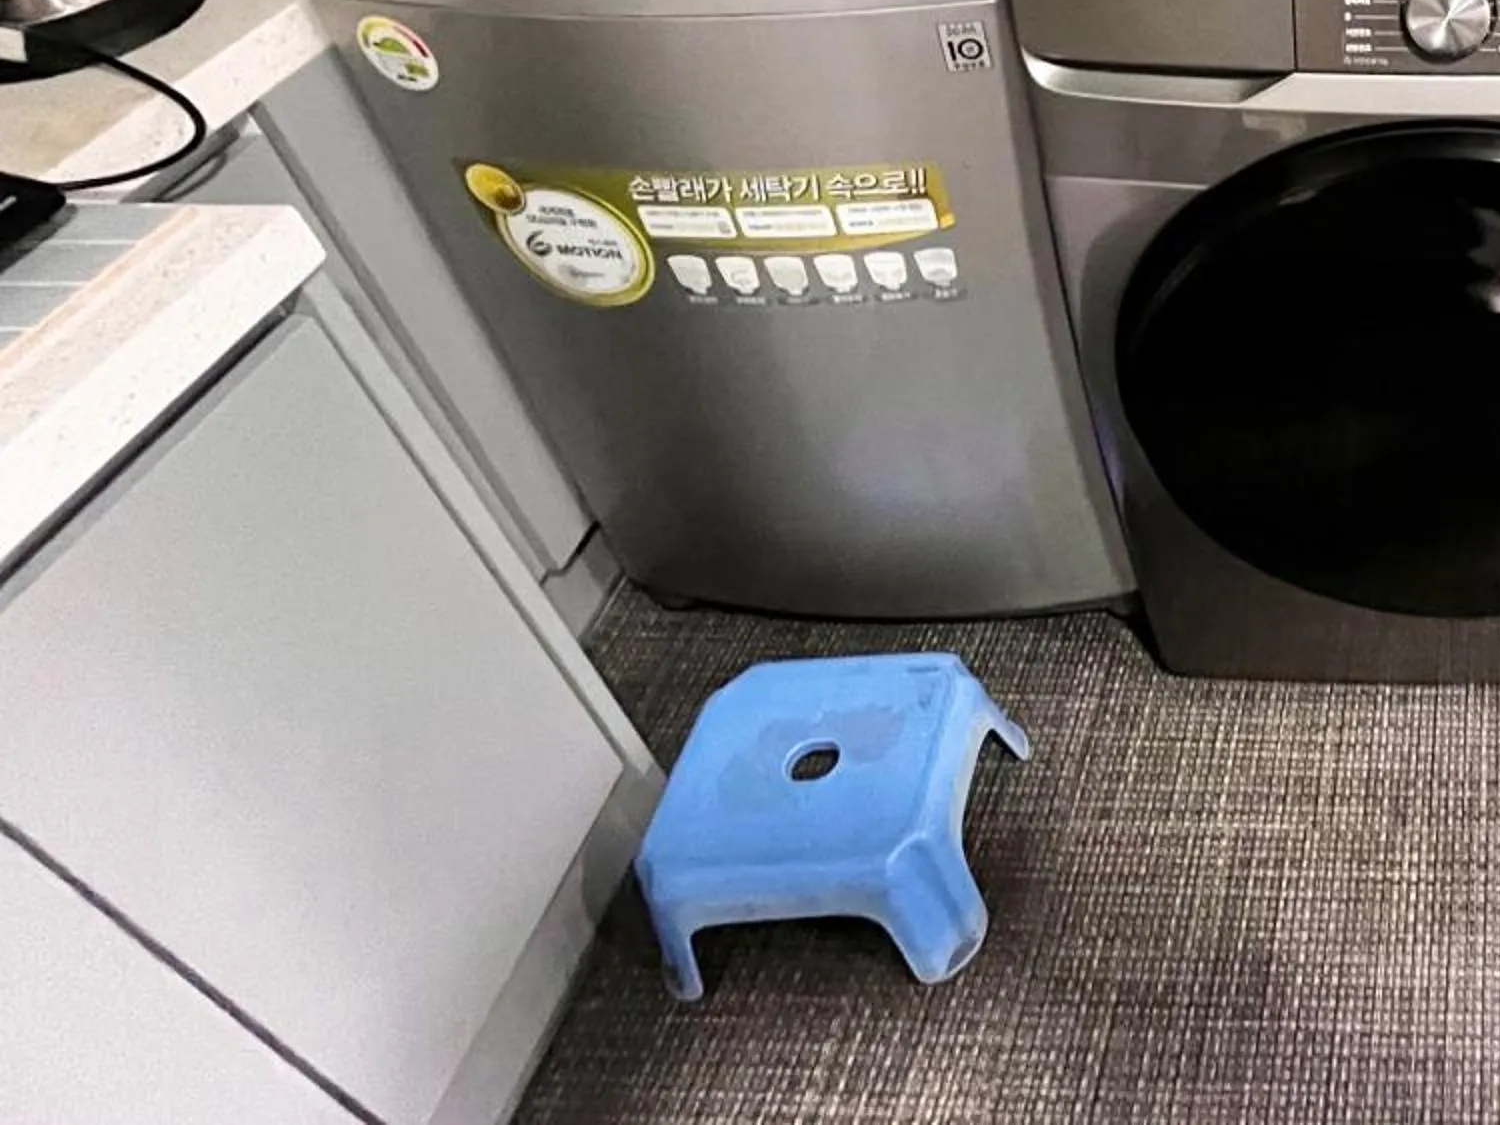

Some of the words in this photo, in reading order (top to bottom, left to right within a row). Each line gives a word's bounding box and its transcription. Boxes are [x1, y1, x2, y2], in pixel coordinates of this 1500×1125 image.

[629, 174, 733, 203] 손빨래가
[739, 173, 822, 202] 세탁기
[827, 167, 928, 197] 속으로!!
